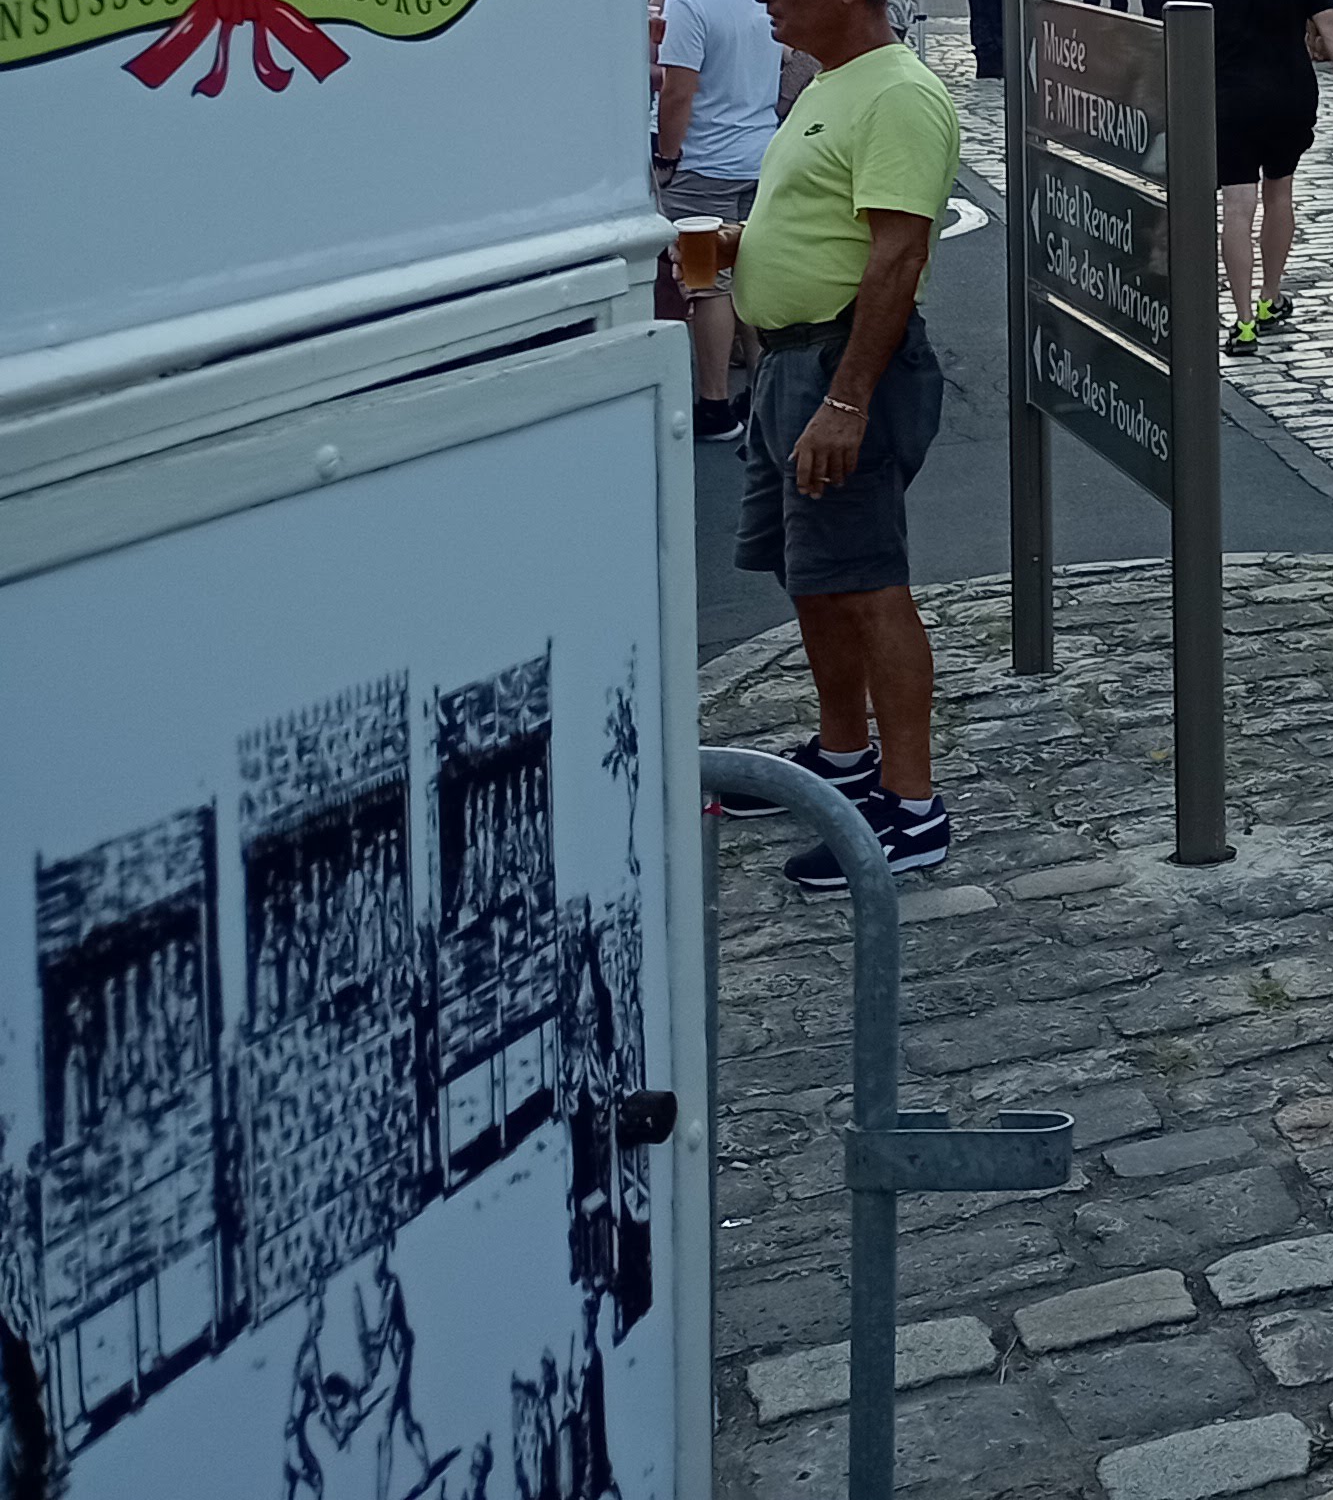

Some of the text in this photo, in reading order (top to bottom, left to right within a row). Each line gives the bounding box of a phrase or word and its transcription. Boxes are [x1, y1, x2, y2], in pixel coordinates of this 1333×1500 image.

[1042, 20, 1087, 73] Musée
[1044, 78, 1149, 155] F. MITTERRAND
[1045, 174, 1134, 255] Hôtel Renard
[1046, 231, 1078, 286] Salle
[1080, 249, 1106, 302] des
[1048, 341, 1169, 463] Salle des Foudres
